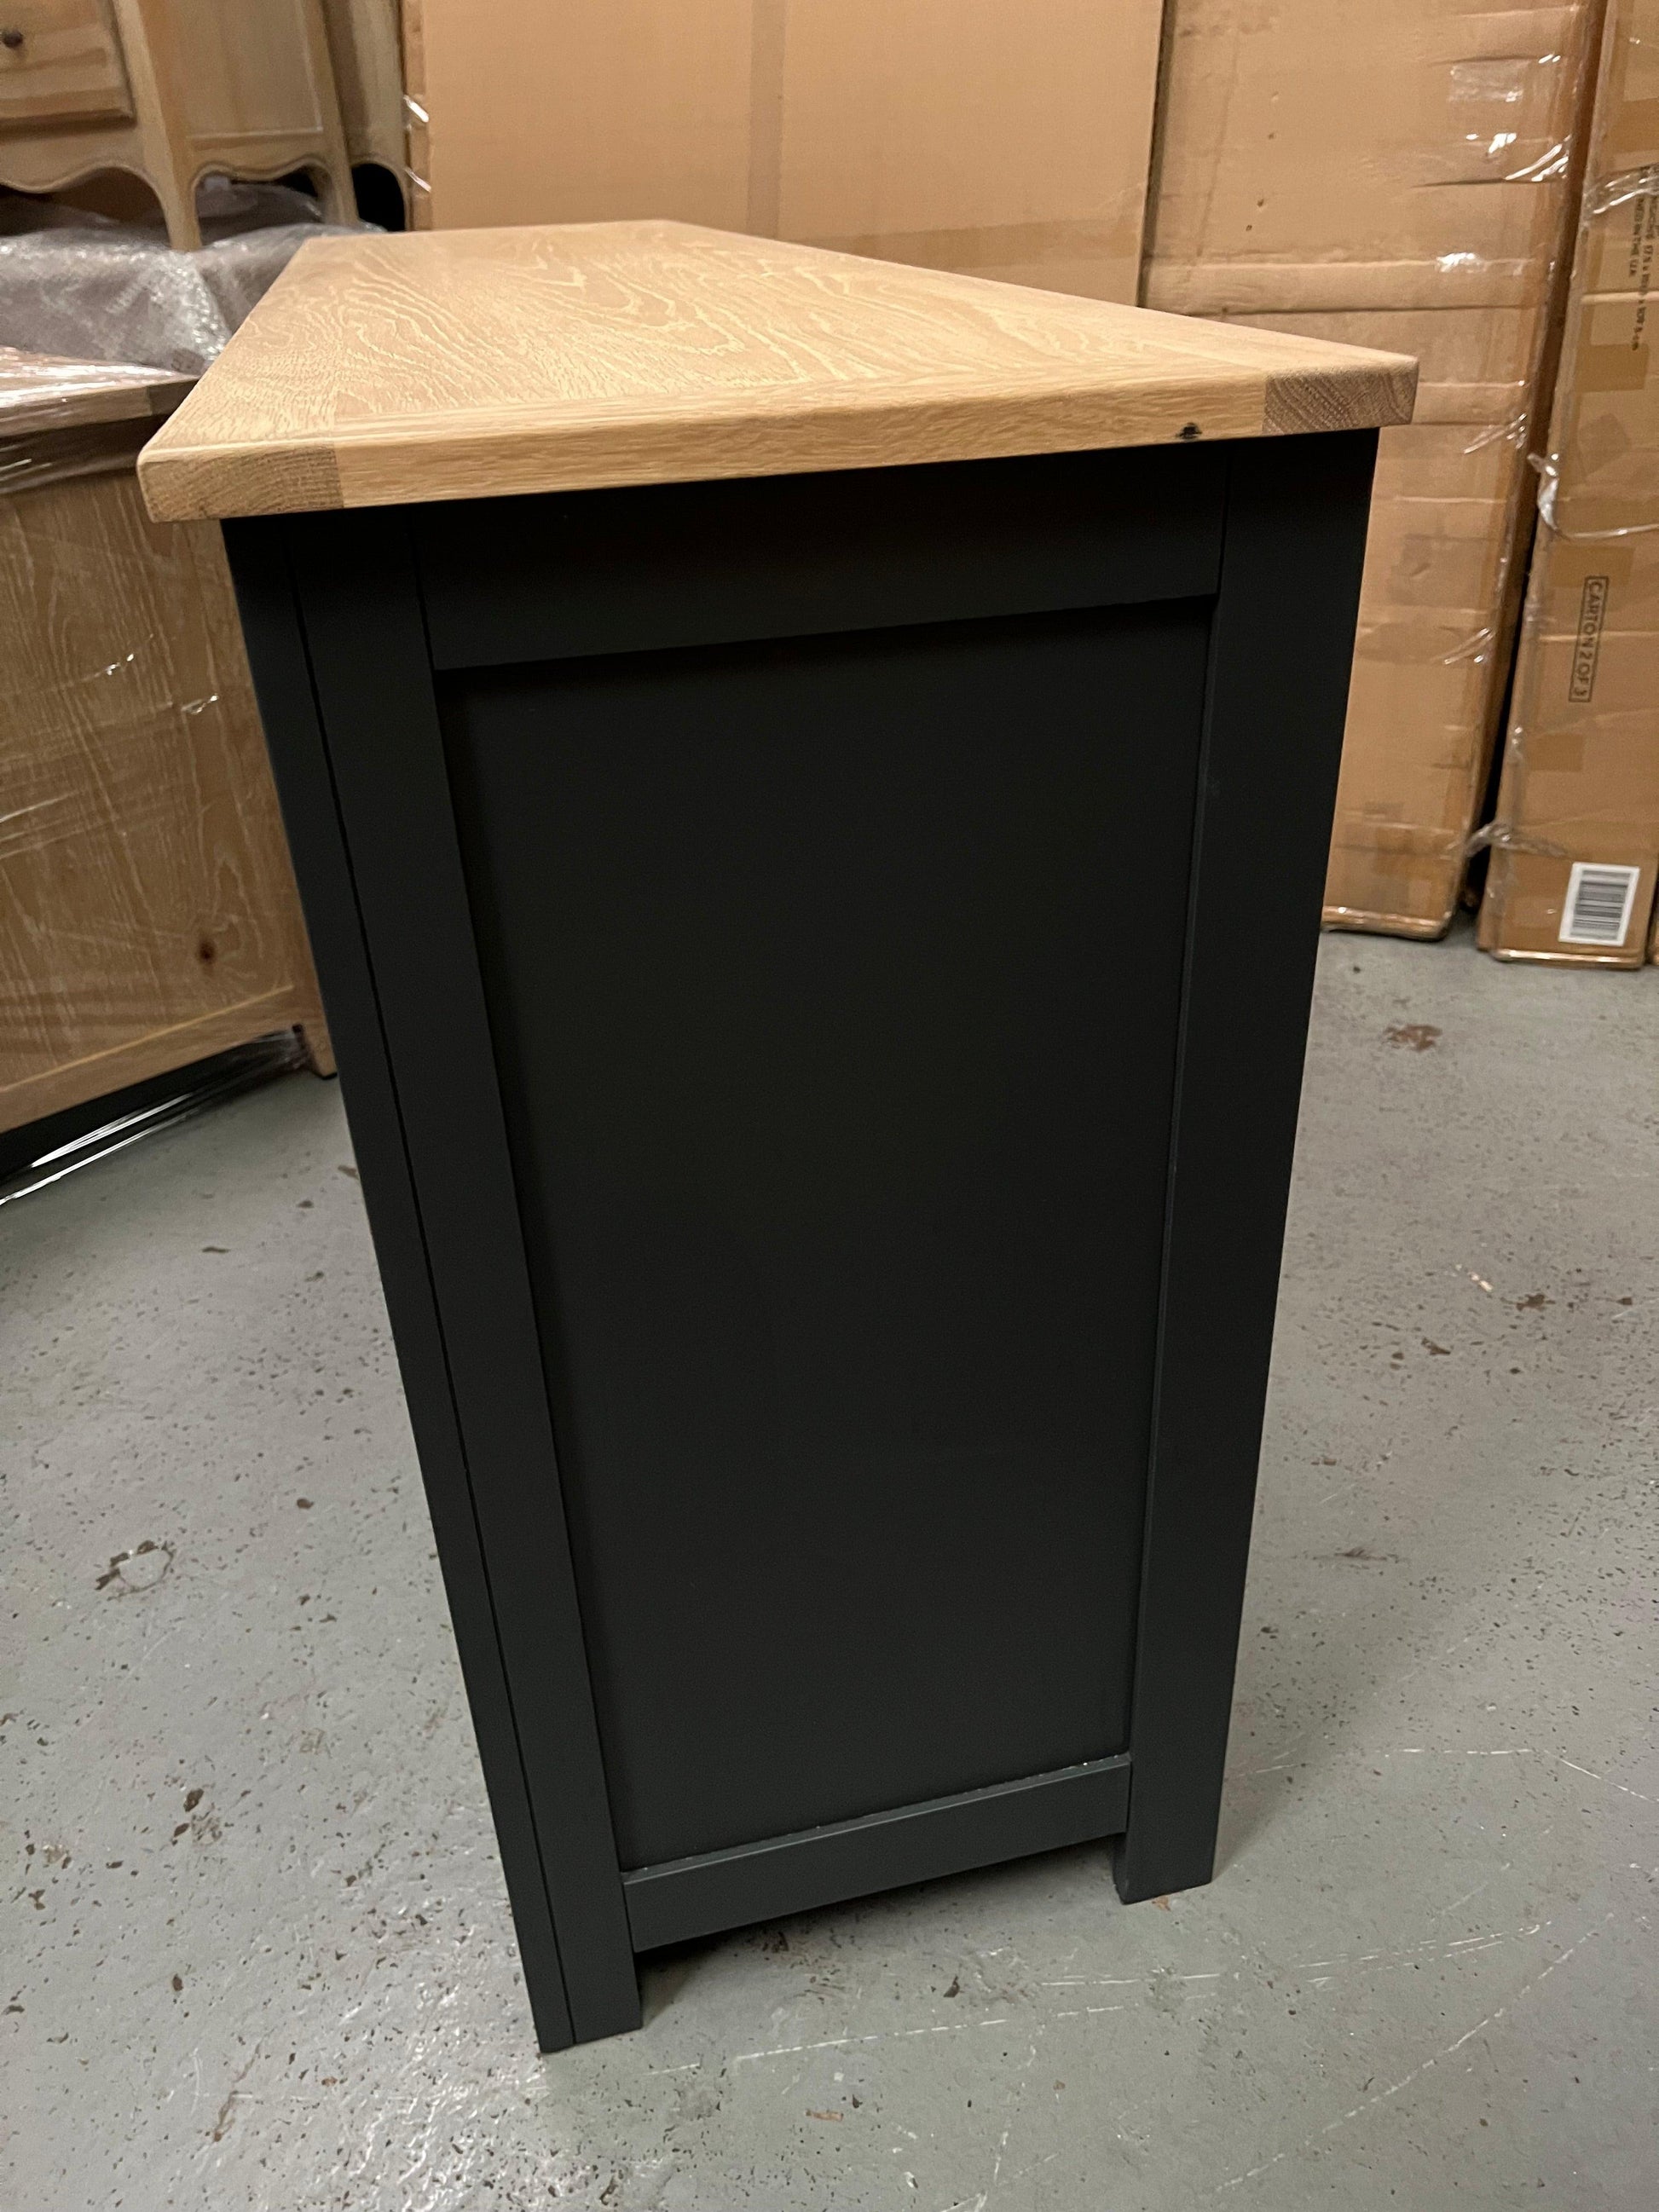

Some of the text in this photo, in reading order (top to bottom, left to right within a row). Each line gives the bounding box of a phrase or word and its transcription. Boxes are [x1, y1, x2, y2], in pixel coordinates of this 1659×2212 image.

[1574, 581, 1603, 696] CARTON 2 OF 3
